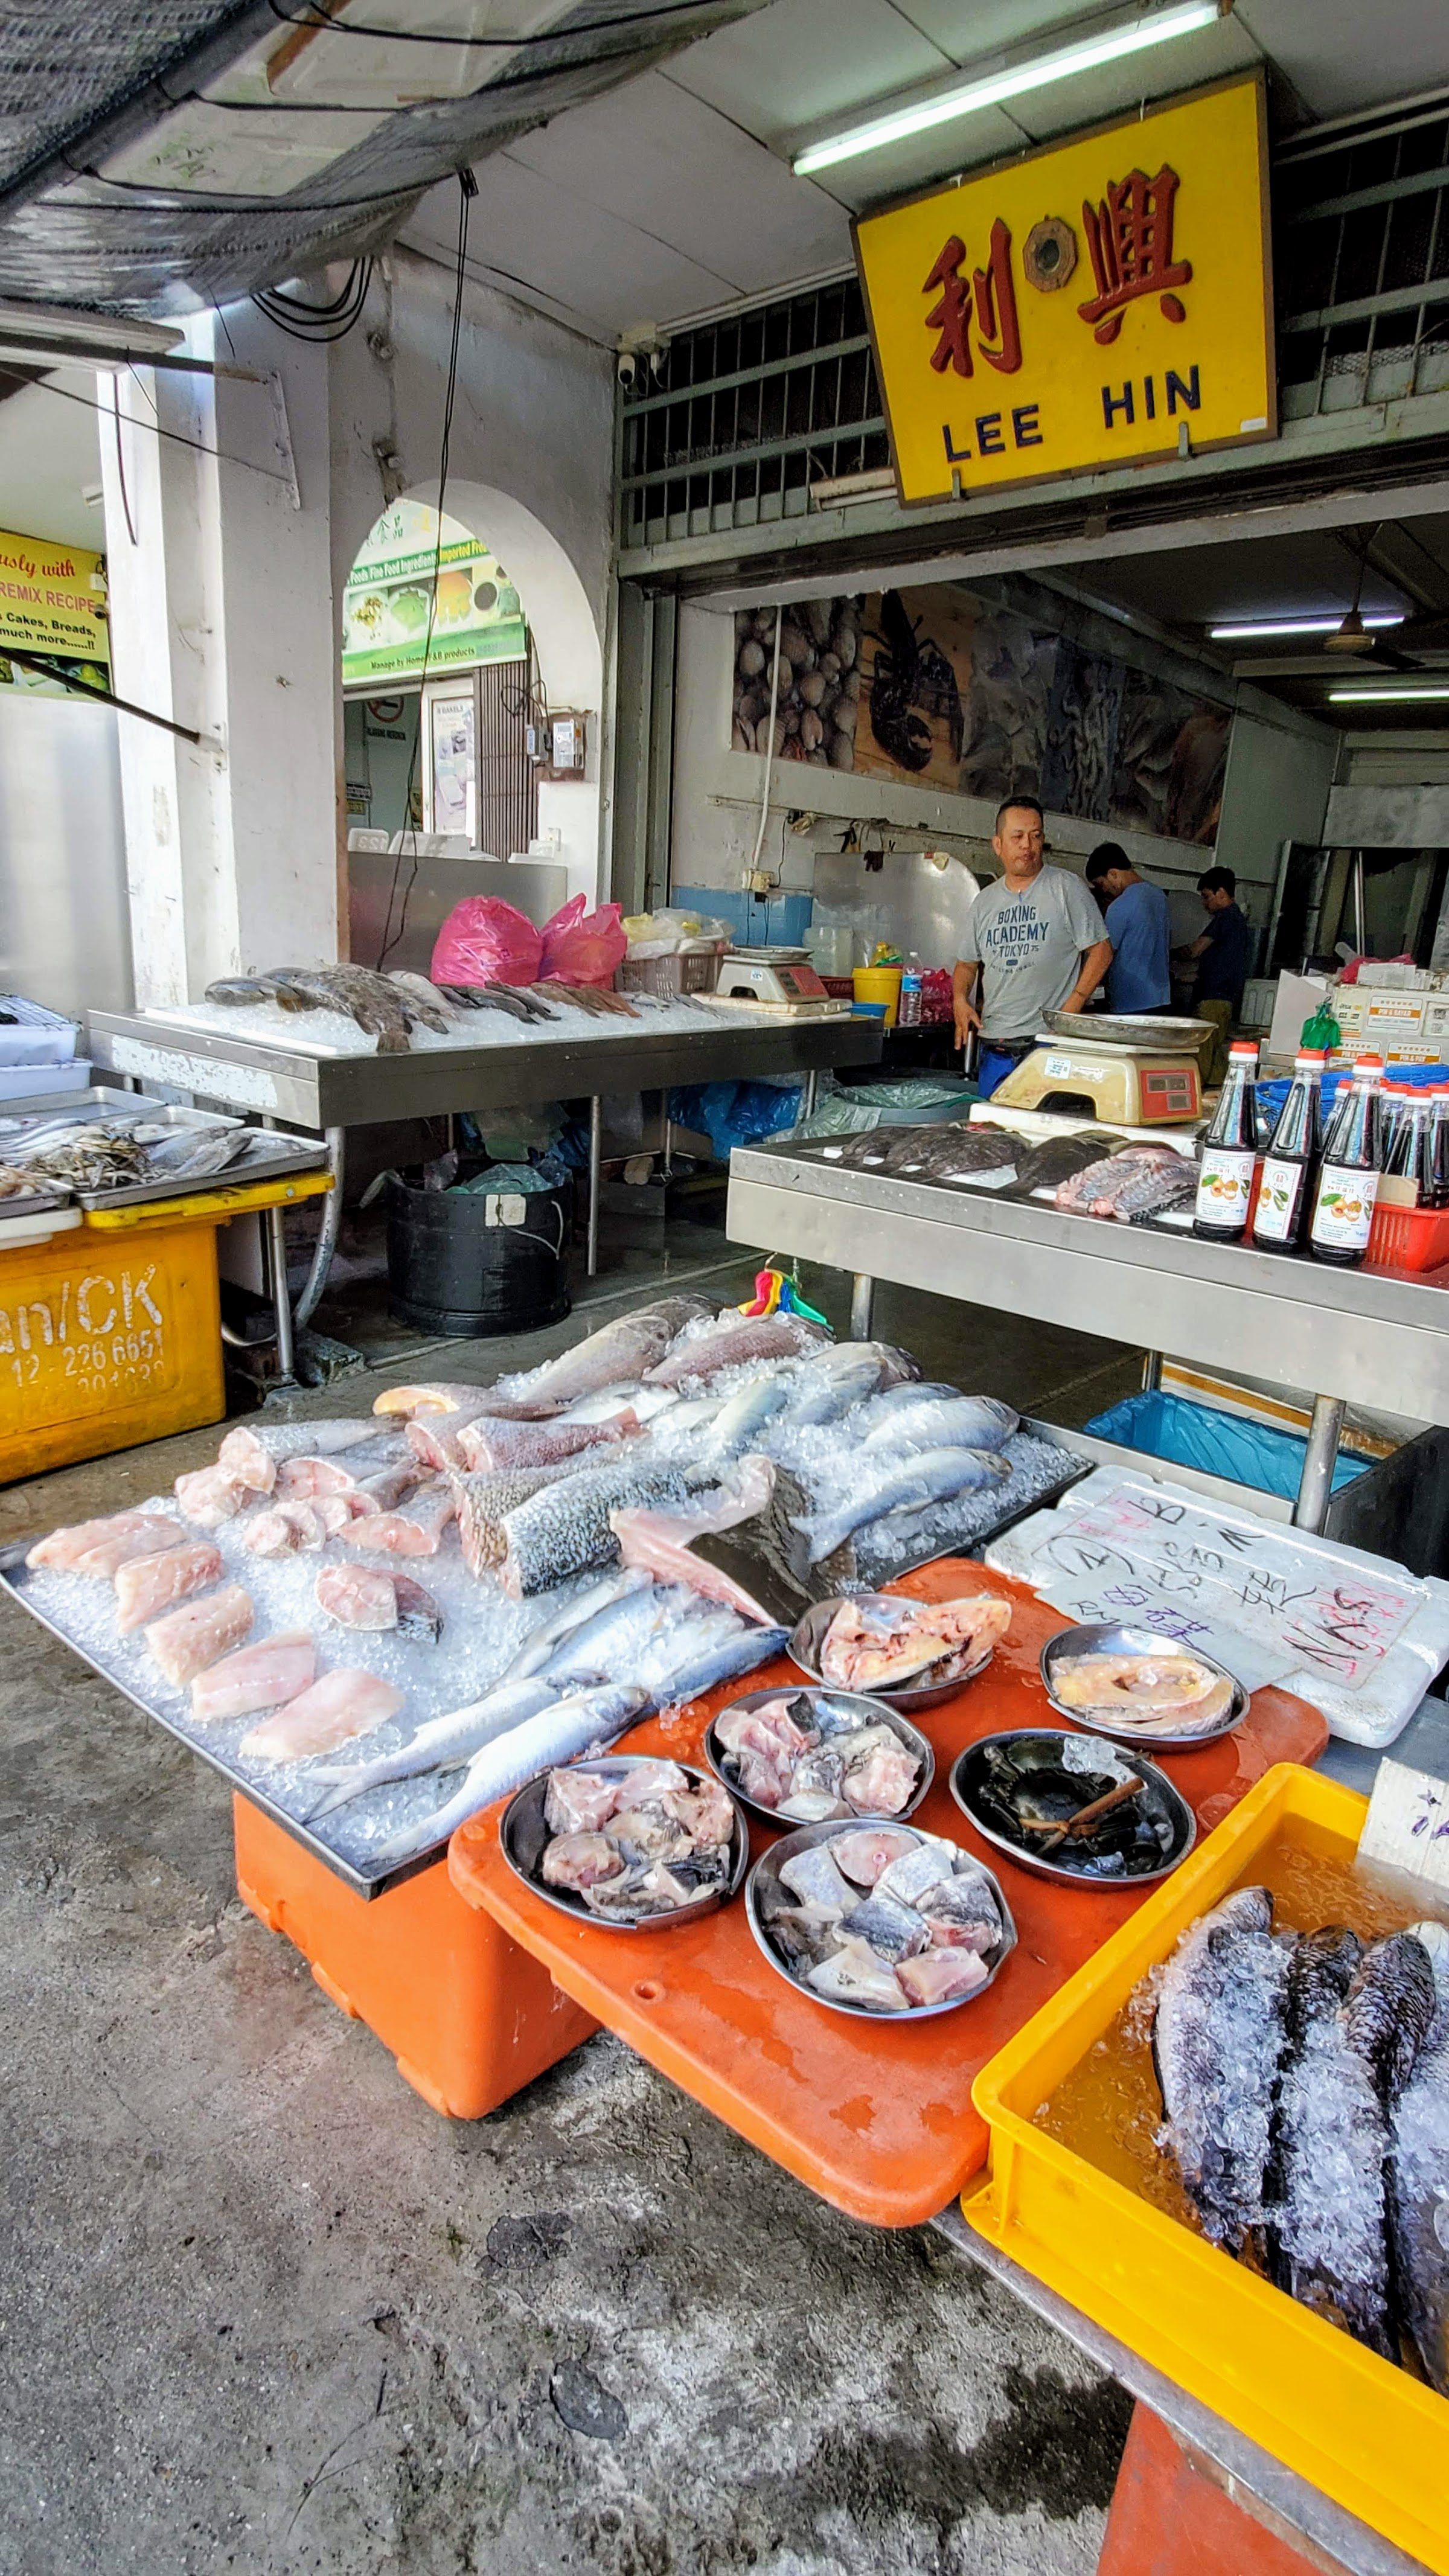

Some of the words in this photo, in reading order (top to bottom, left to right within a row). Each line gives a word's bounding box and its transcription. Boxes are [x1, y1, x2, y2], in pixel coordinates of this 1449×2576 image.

[942, 403, 1043, 463] LEE
[1101, 365, 1201, 429] HIN
[42, 558, 75, 578] with
[46, 590, 95, 614] RECIPE
[6, 612, 48, 630] Cakes,
[51, 619, 96, 638] Breads,
[444, 648, 475, 662] products
[998, 905, 1036, 925] BOXING
[985, 922, 1049, 948] ACADEMY
[999, 943, 1029, 957] TOKYO
